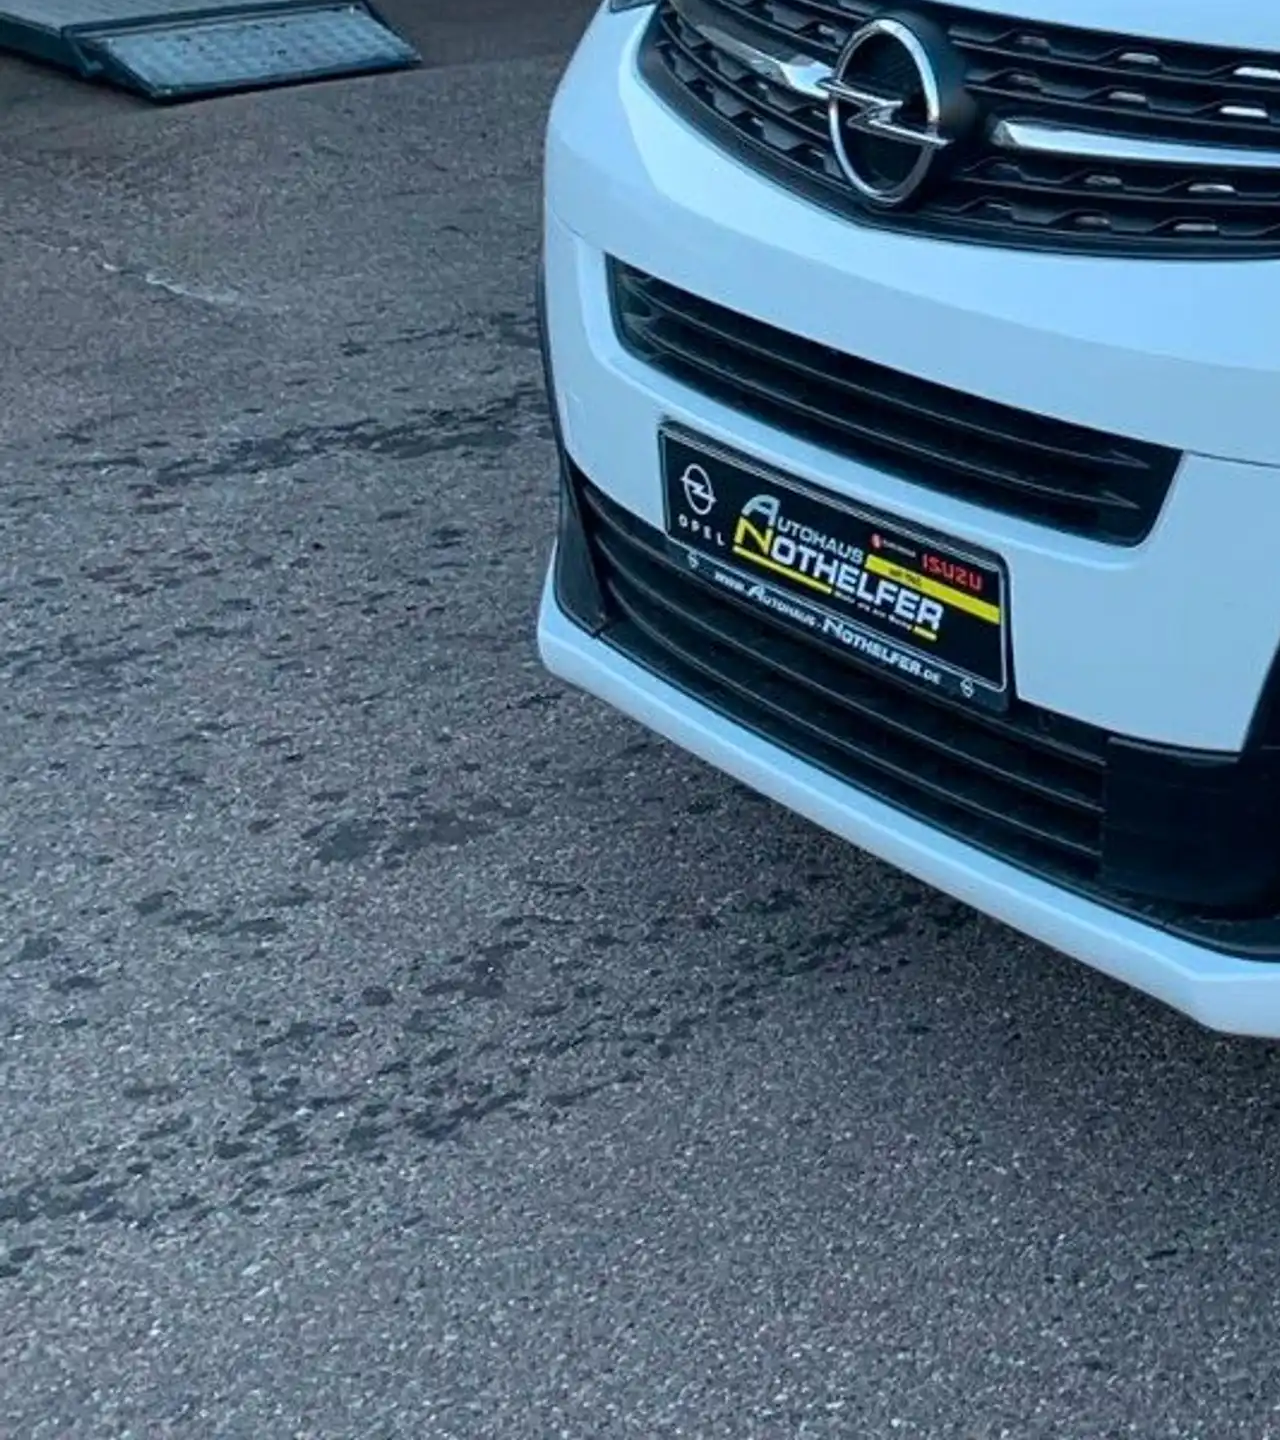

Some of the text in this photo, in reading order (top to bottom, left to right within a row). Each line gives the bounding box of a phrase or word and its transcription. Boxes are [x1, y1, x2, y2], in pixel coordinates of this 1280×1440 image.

[678, 513, 726, 547] OPEL
[734, 517, 944, 631] NOTHELFER
[922, 552, 984, 592] ISUZU
